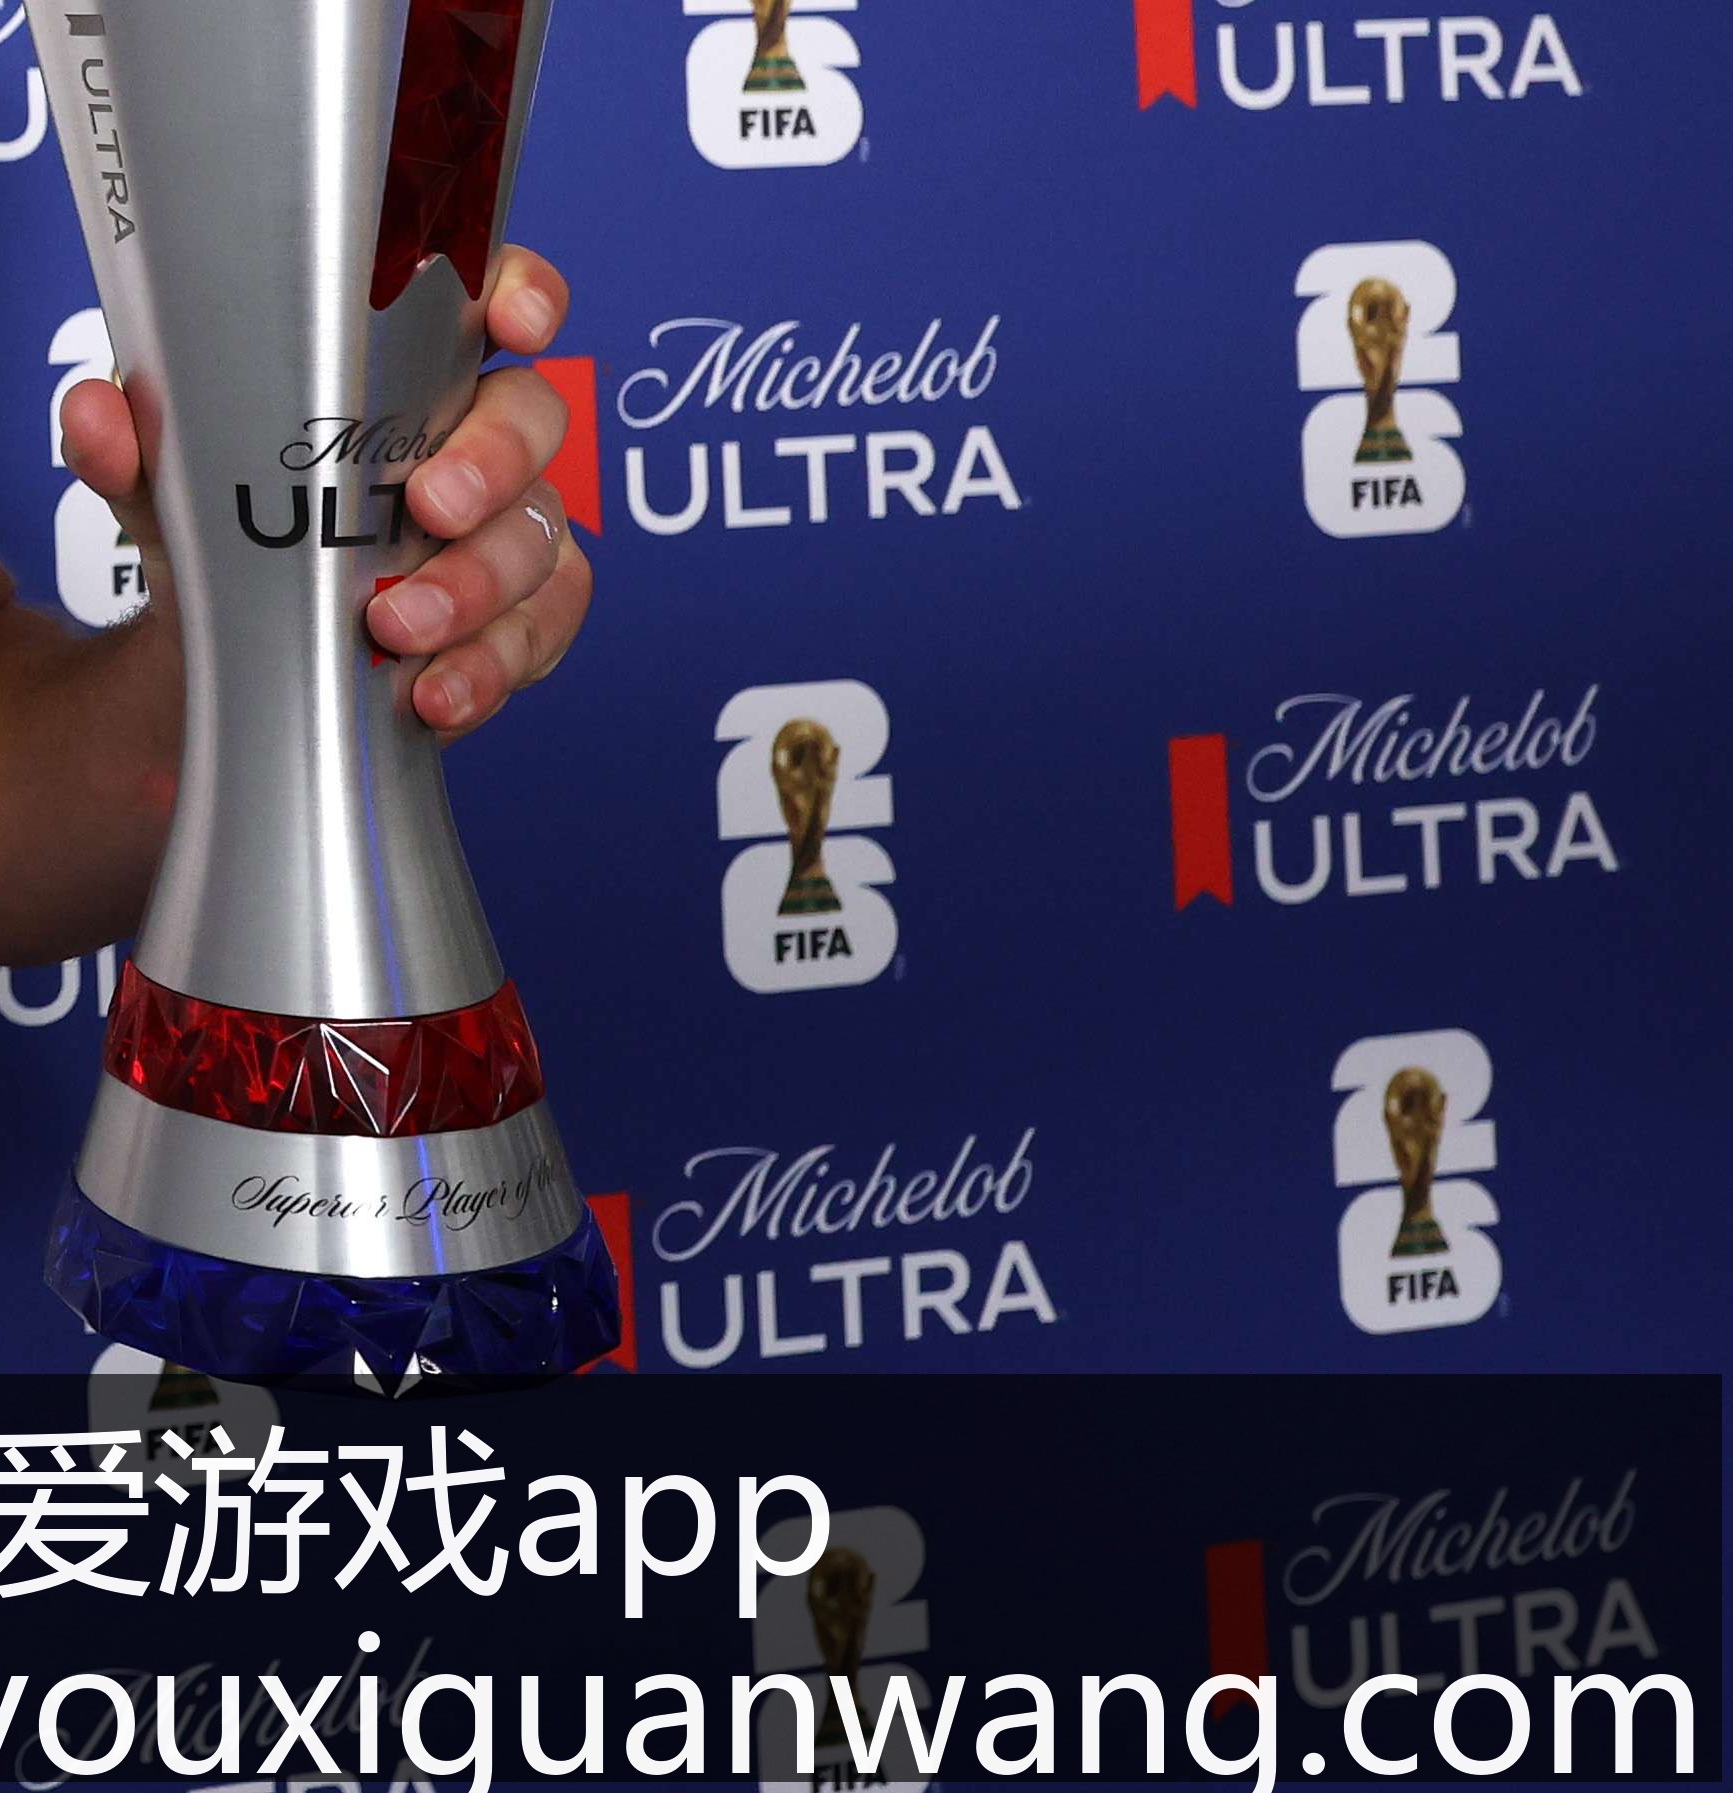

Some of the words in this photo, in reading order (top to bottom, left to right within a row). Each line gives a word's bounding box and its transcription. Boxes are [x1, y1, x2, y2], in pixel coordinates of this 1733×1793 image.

[1217, 14, 1582, 110] ULTRA
[81, 59, 136, 244] ULTRA
[740, 108, 816, 139] FIFA
[618, 315, 999, 428] Michelob
[235, 483, 407, 549] ULT
[625, 426, 1022, 535] ULTRA
[1351, 477, 1423, 509] FIFA
[1247, 684, 1597, 804] Michelob
[1255, 792, 1618, 904] ULTRA
[775, 927, 852, 964] FIFA
[395, 1176, 509, 1231] Player
[653, 1128, 1036, 1263] Michelob
[661, 1242, 1057, 1368] ULTRA
[1388, 1268, 1459, 1304] FIFA
[1284, 1469, 1639, 1606] Michelob
[1292, 1579, 1658, 1706] ULTRA
